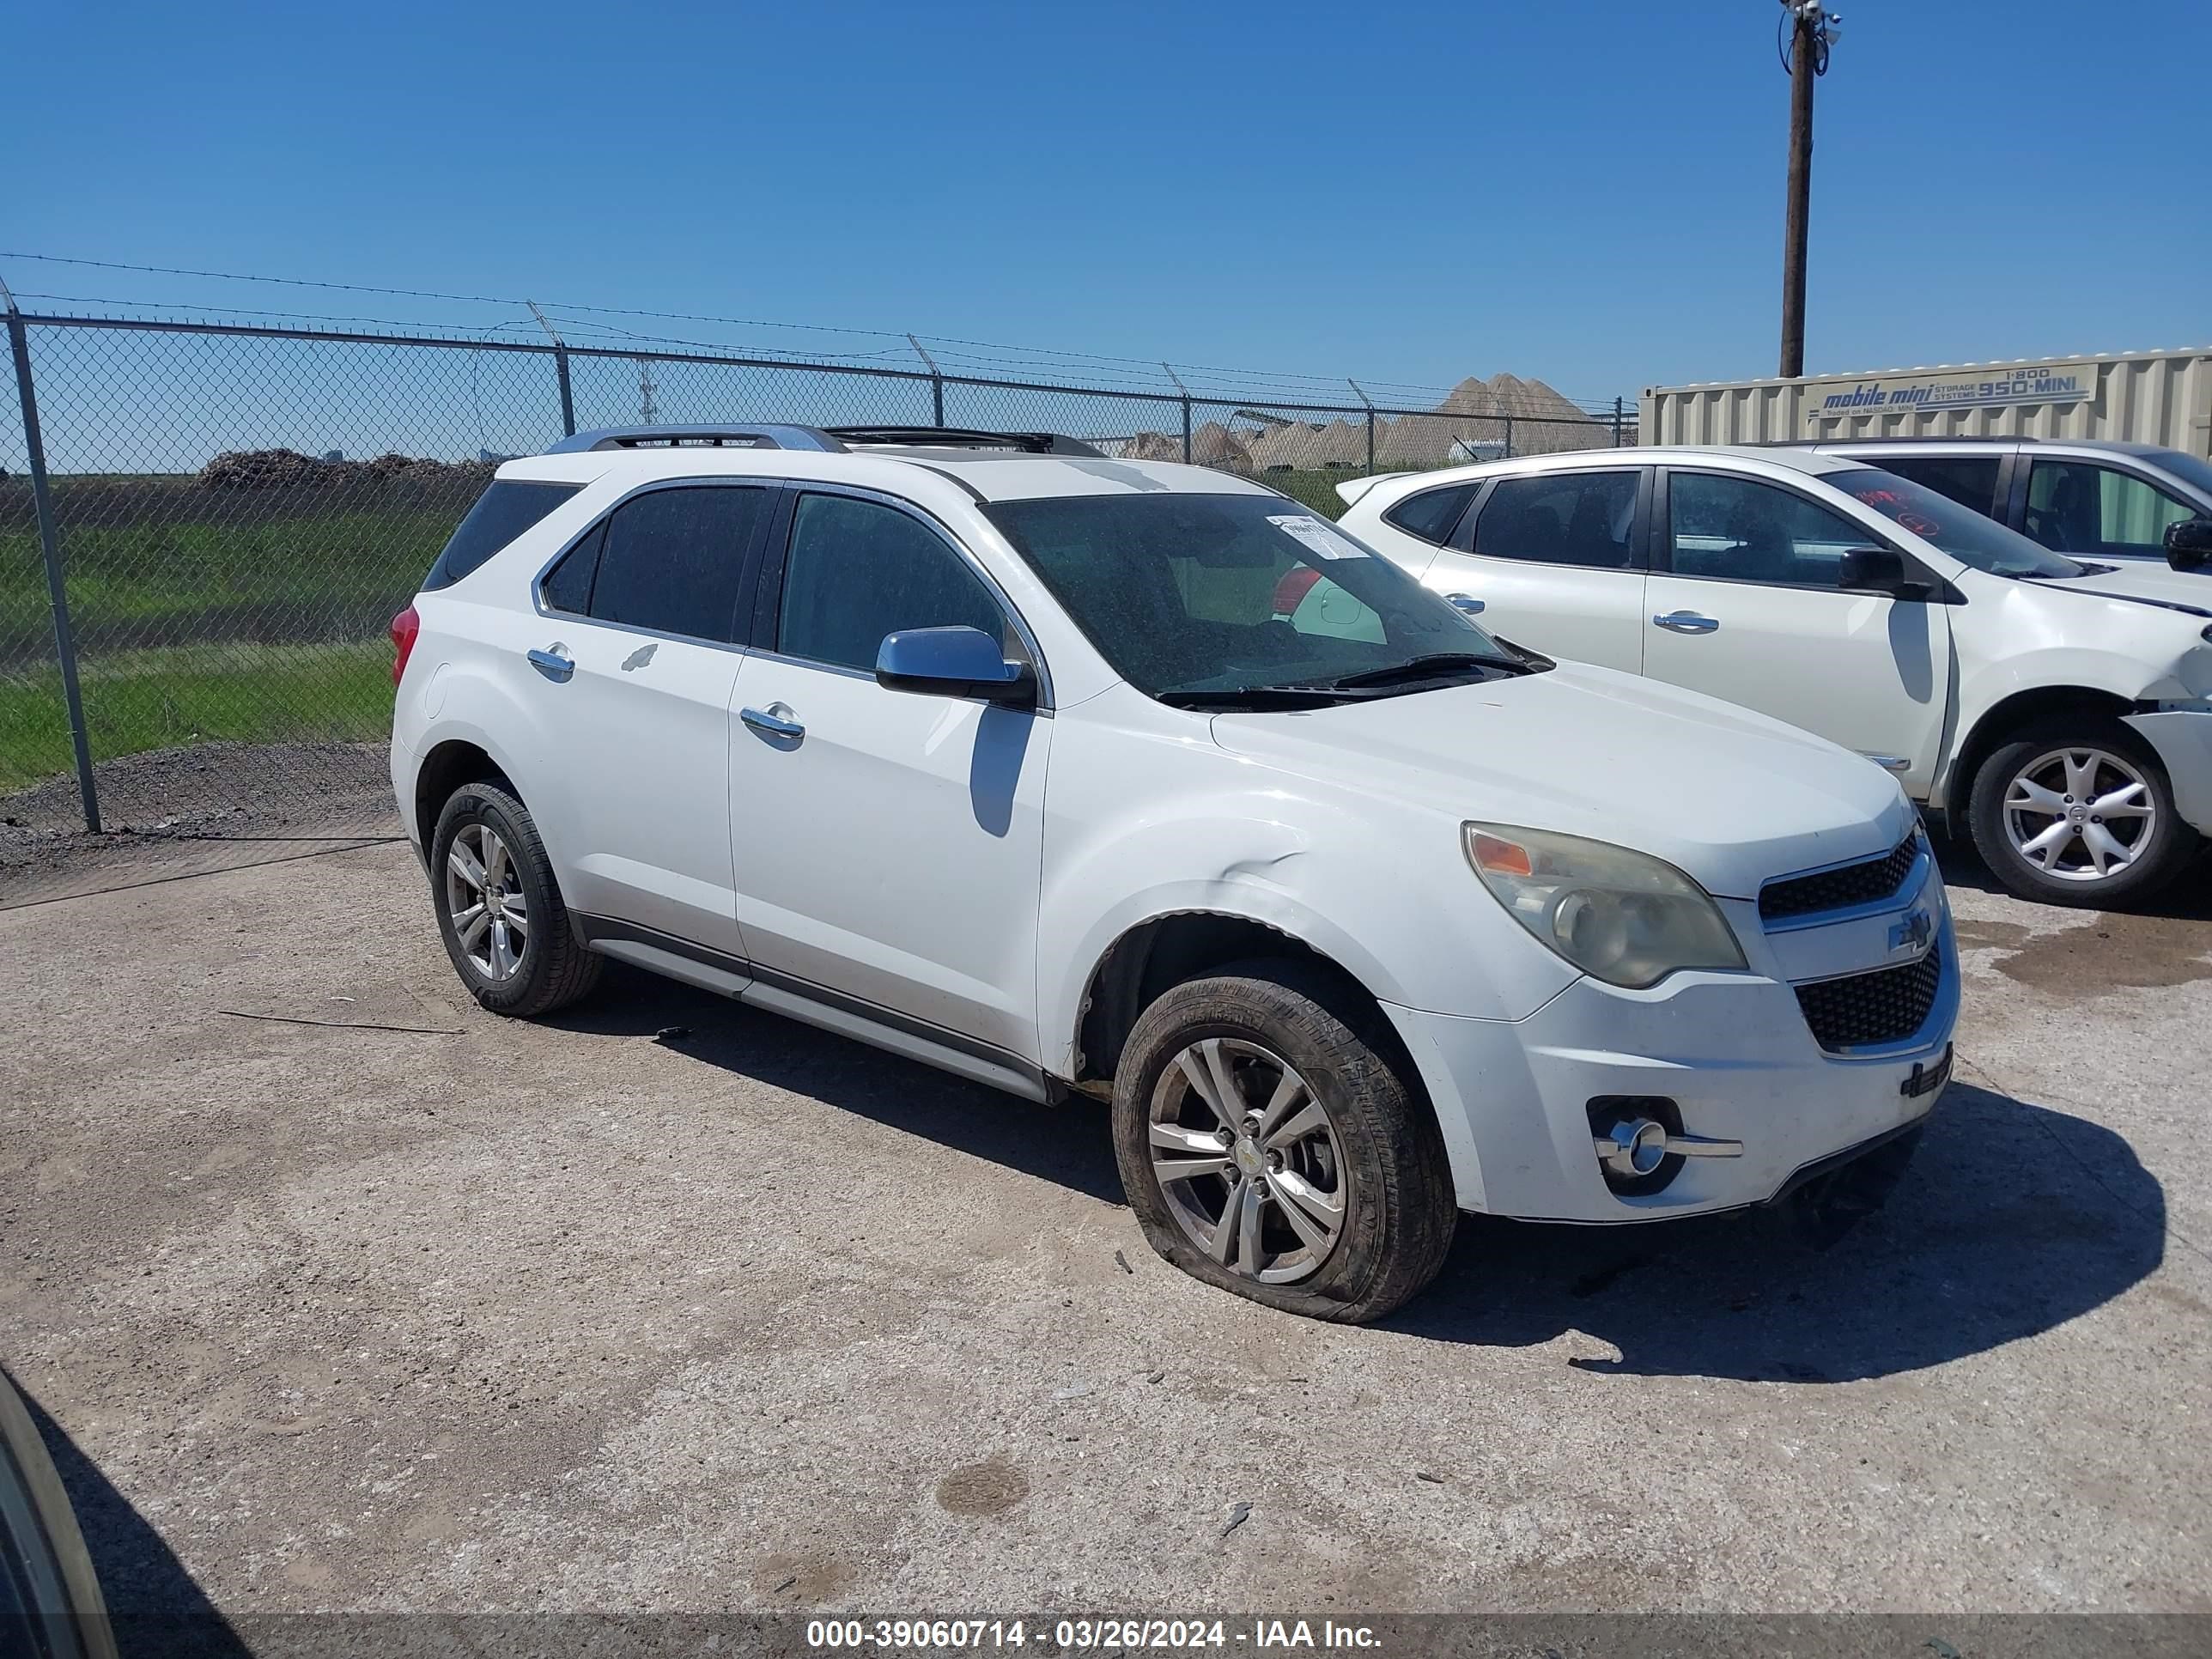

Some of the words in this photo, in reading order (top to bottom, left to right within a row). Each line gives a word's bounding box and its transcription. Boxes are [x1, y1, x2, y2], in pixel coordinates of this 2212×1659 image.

[1935, 384, 1975, 393] STORAGE
[1823, 383, 1887, 409] mobile
[1888, 384, 1935, 404] mini
[1934, 391, 1976, 400] SYSTEMS
